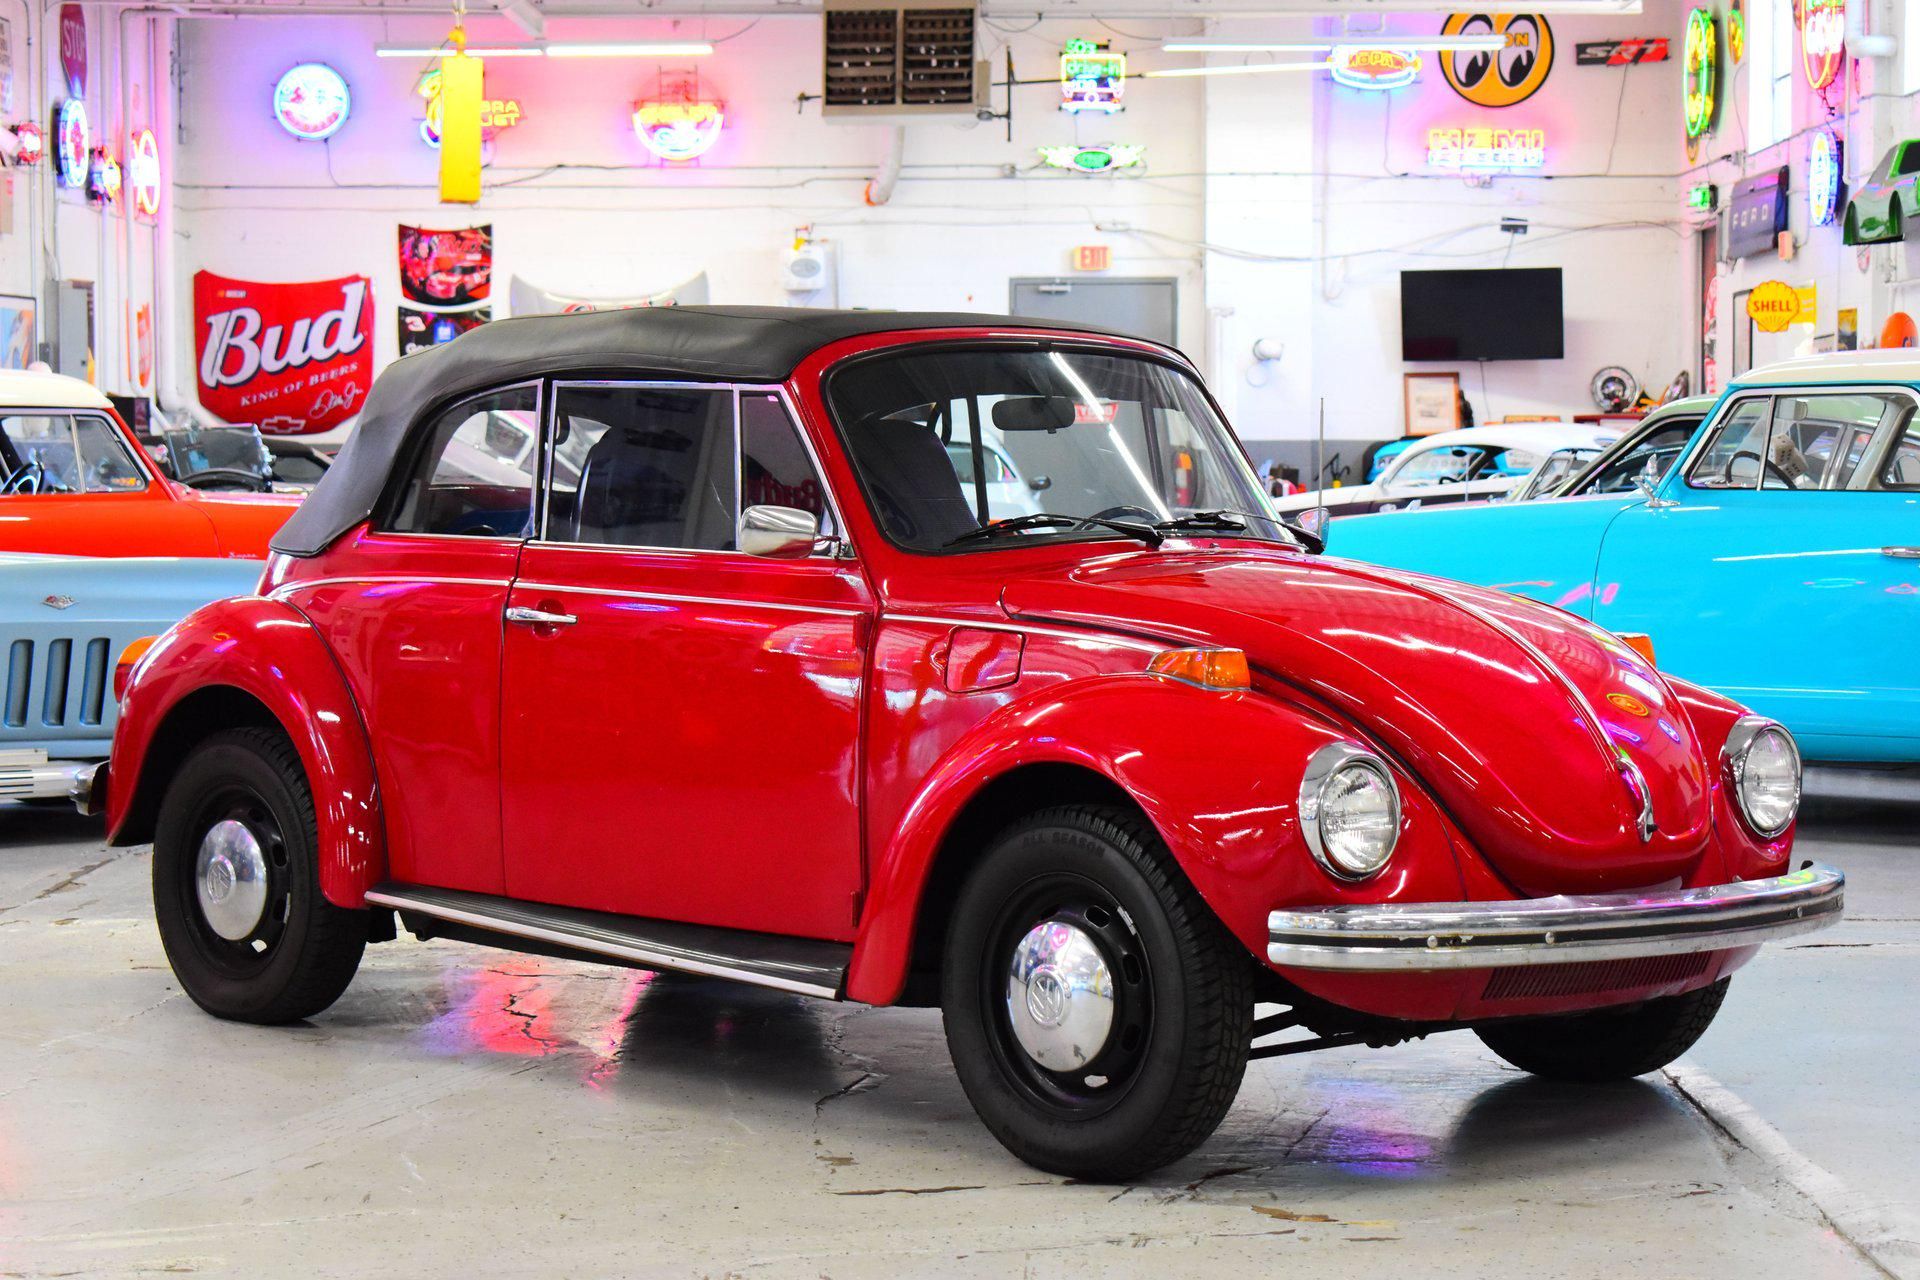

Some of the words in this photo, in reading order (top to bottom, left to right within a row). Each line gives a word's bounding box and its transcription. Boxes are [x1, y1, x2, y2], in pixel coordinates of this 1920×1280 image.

[1733, 203, 1769, 230] FORD
[1080, 246, 1108, 269] EXIT
[1753, 300, 1792, 313] SHELL
[201, 280, 366, 389] Bud
[241, 389, 279, 407] KING
[284, 382, 304, 395] OF
[309, 361, 359, 387] BEERS
